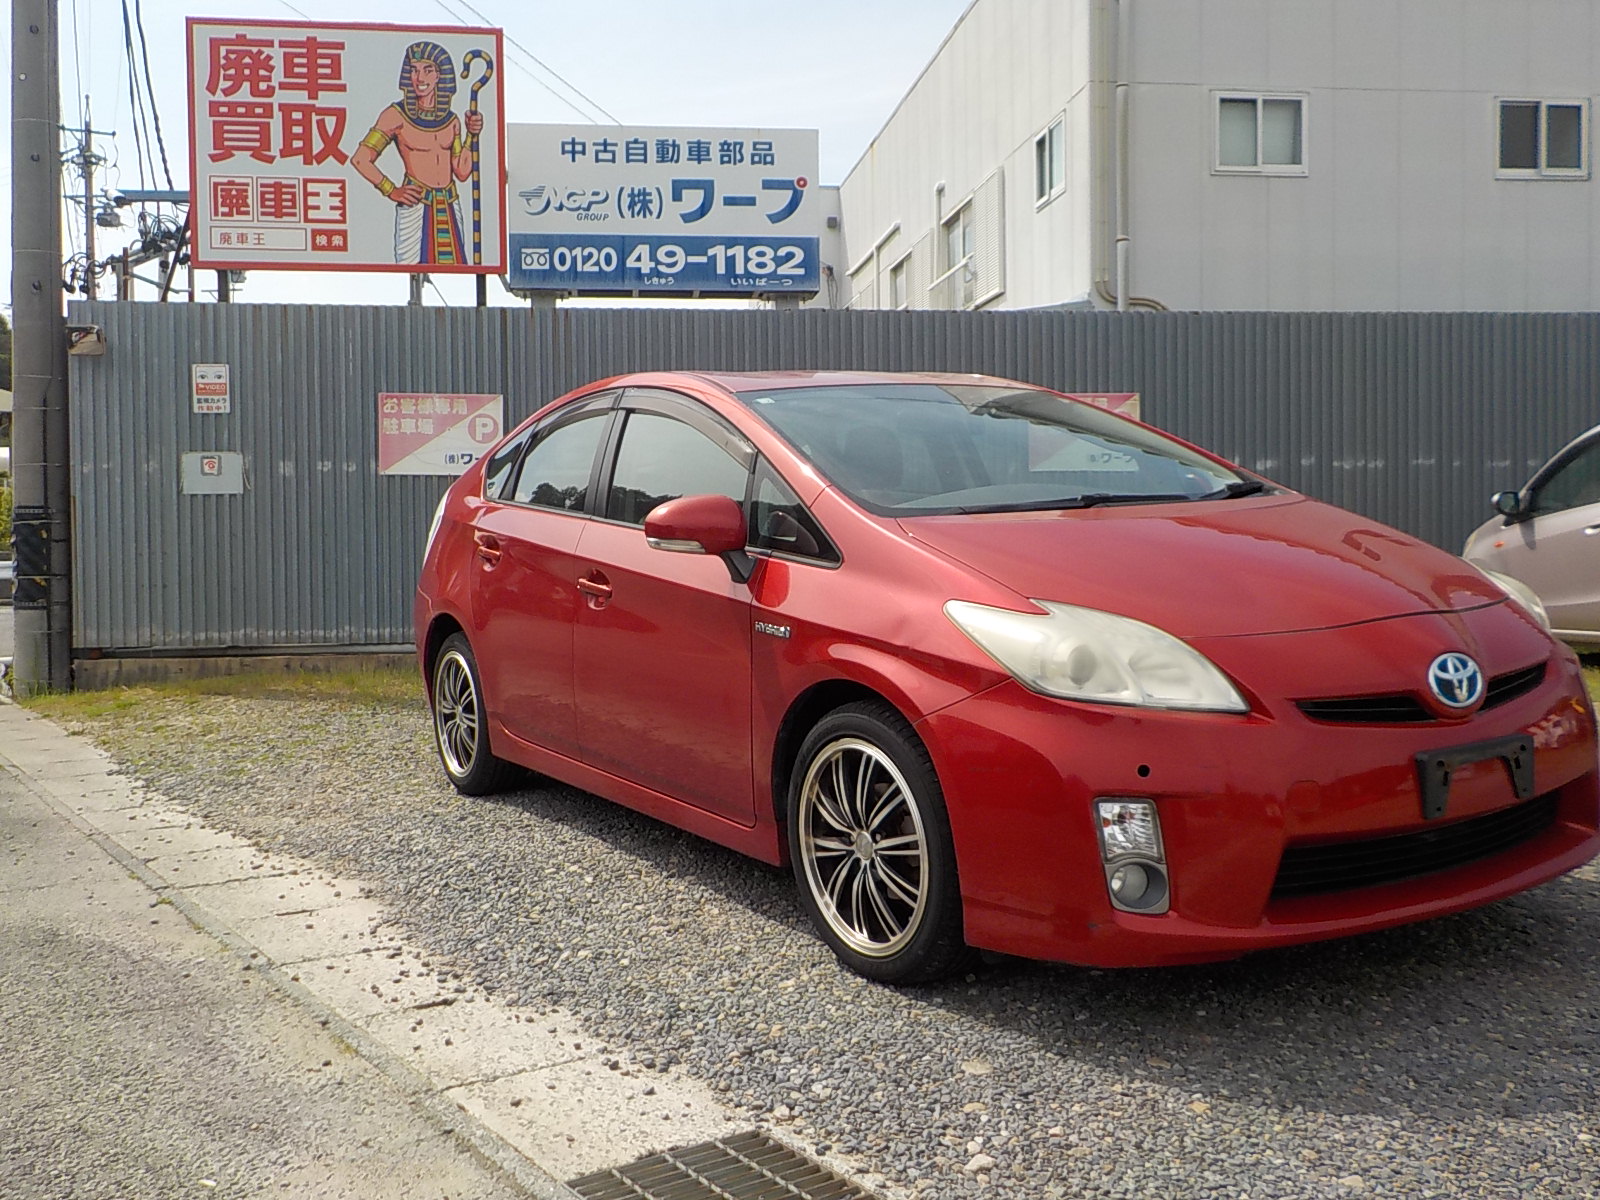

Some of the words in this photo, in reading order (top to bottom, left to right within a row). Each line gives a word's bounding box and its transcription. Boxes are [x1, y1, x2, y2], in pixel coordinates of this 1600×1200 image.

[205, 33, 347, 100] 廃車
[207, 100, 349, 166] 買取
[560, 136, 776, 166] 中古自動車部品
[210, 176, 347, 224] 廃車王
[576, 212, 610, 221] GROUP
[219, 232, 266, 246] 廃車王
[315, 234, 344, 246] 検索
[553, 246, 617, 272] 0120
[625, 244, 805, 275] 49-1182
[475, 417, 494, 441] P
